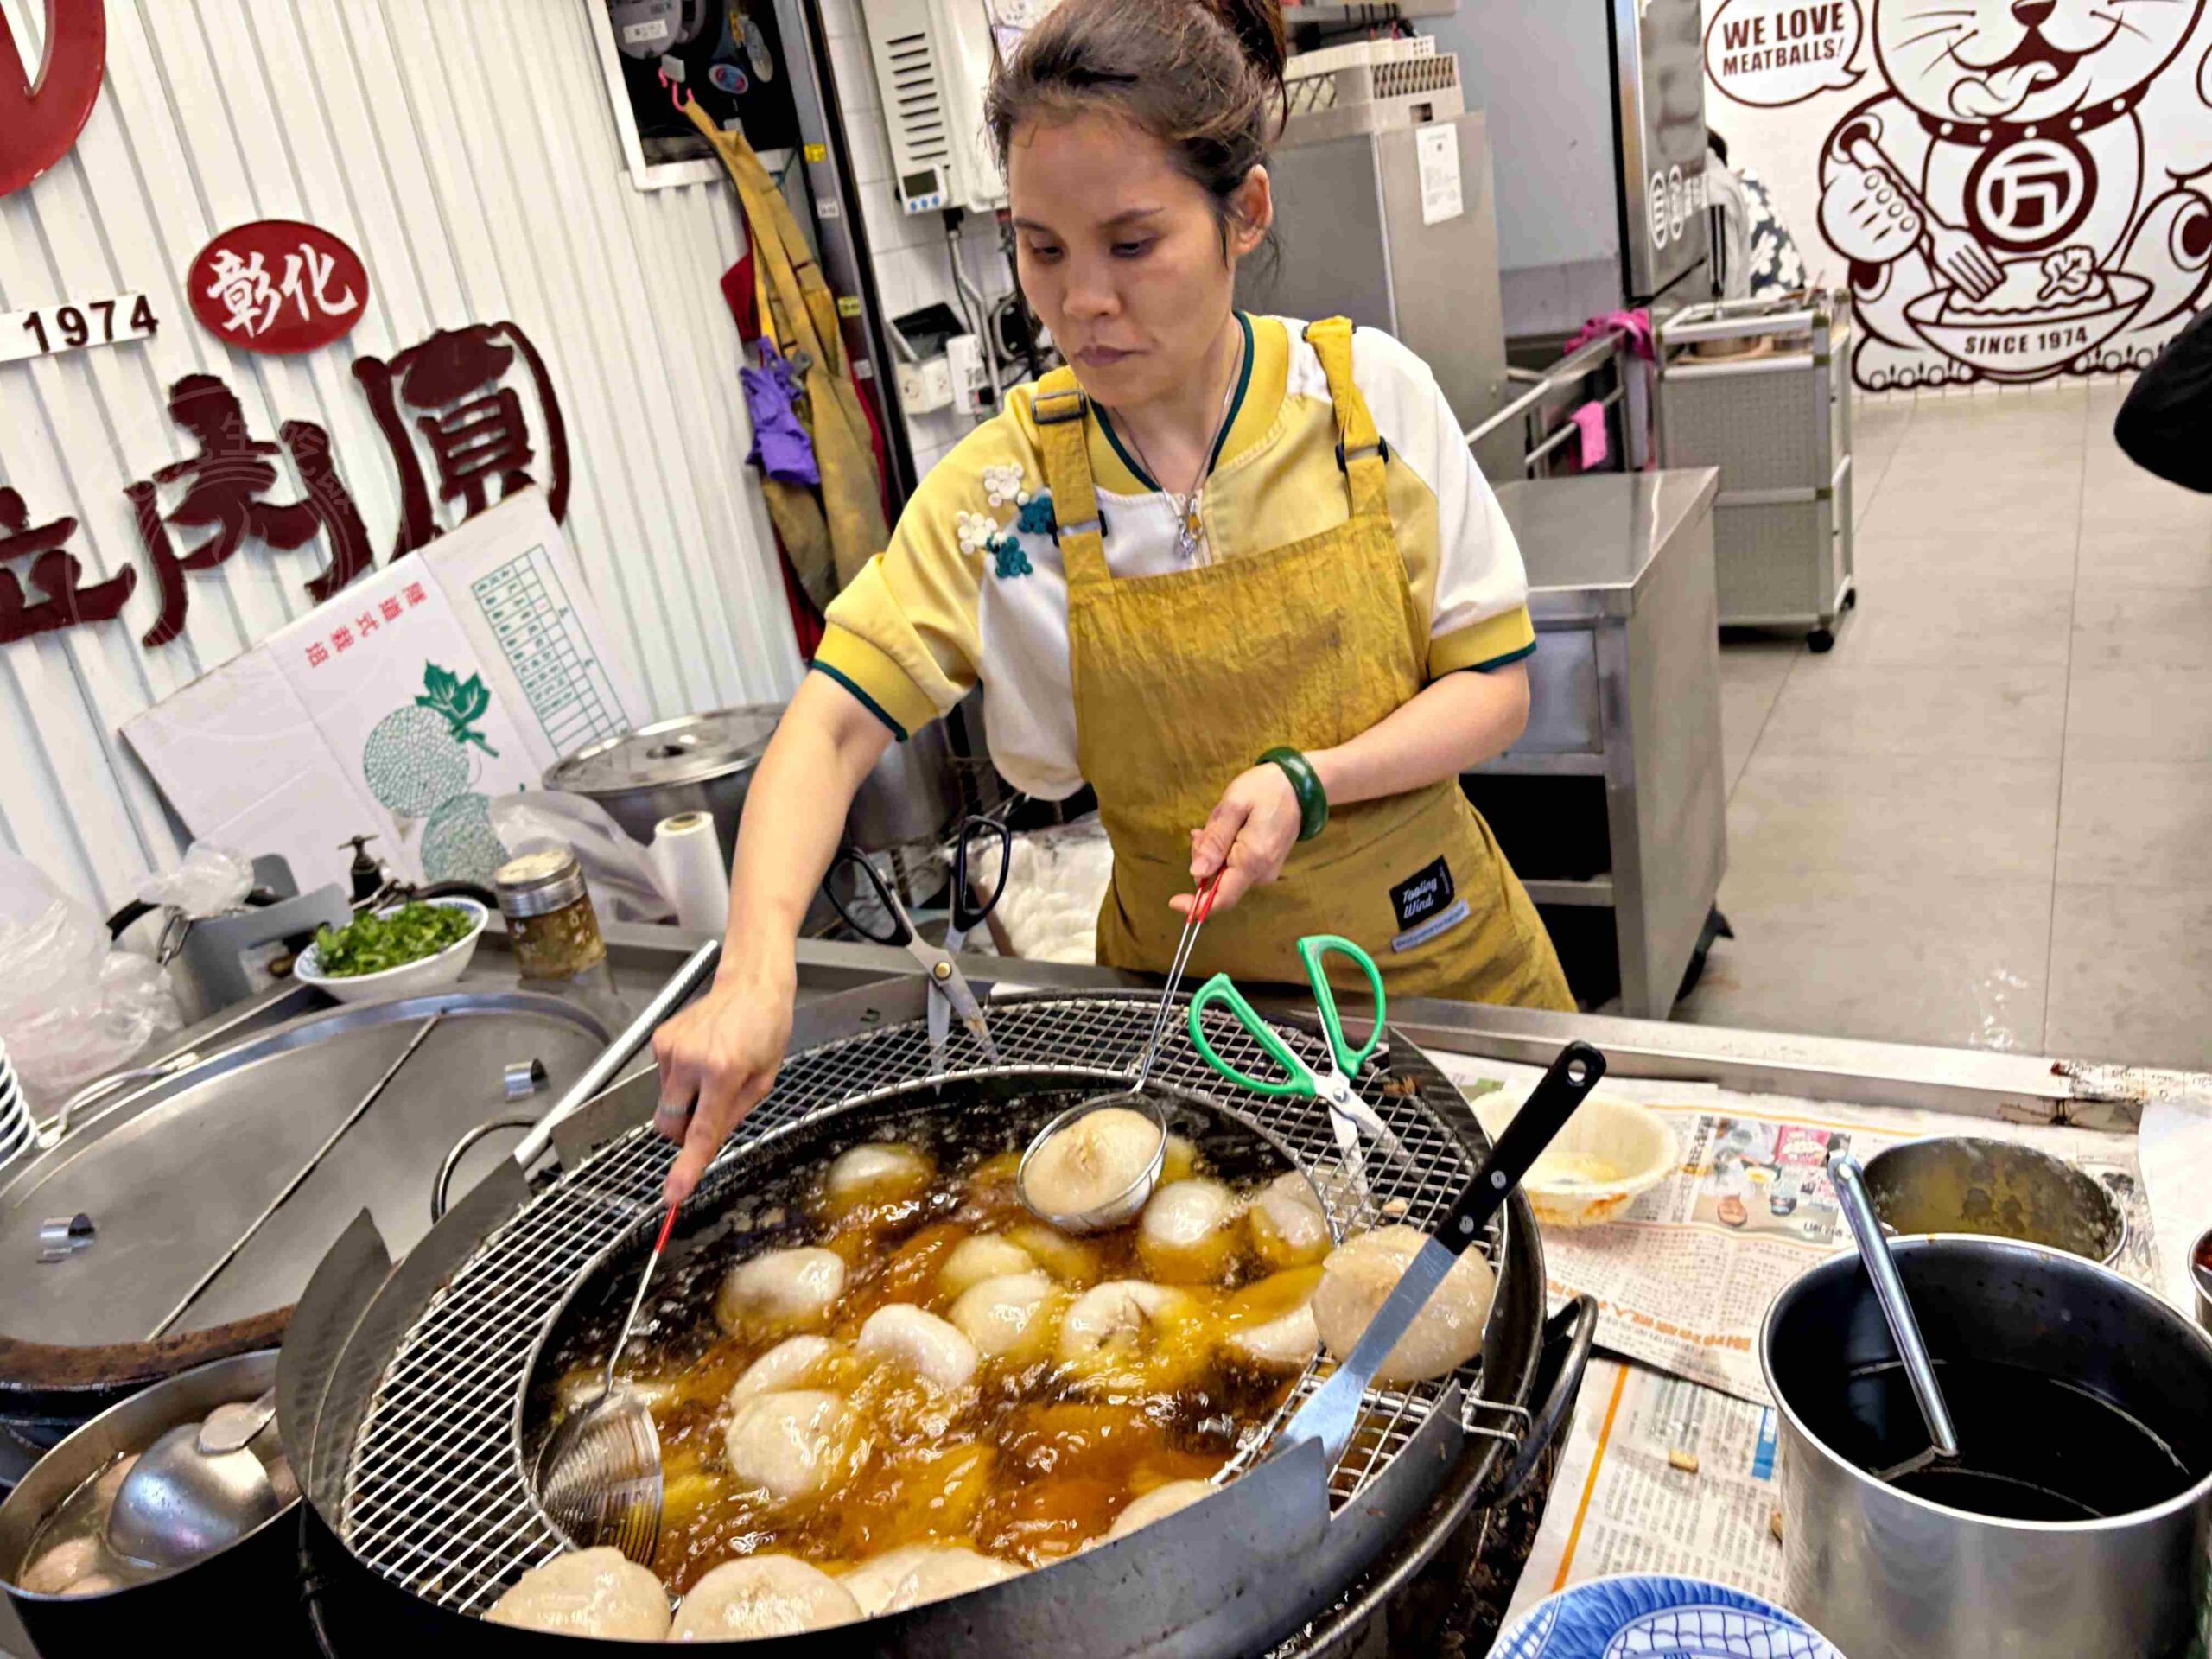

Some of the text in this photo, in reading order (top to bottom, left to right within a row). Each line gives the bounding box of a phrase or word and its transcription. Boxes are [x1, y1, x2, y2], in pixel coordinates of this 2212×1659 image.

[1723, 2, 1845, 51] WE LOVE
[1722, 37, 1845, 76] MEATBALLS!
[207, 243, 359, 339] 彰化
[22, 294, 160, 353] 1974
[1964, 326, 2088, 355] SINCE 1974
[305, 581, 428, 669] 隧道式栽培
[1403, 893, 1435, 919] Wind
